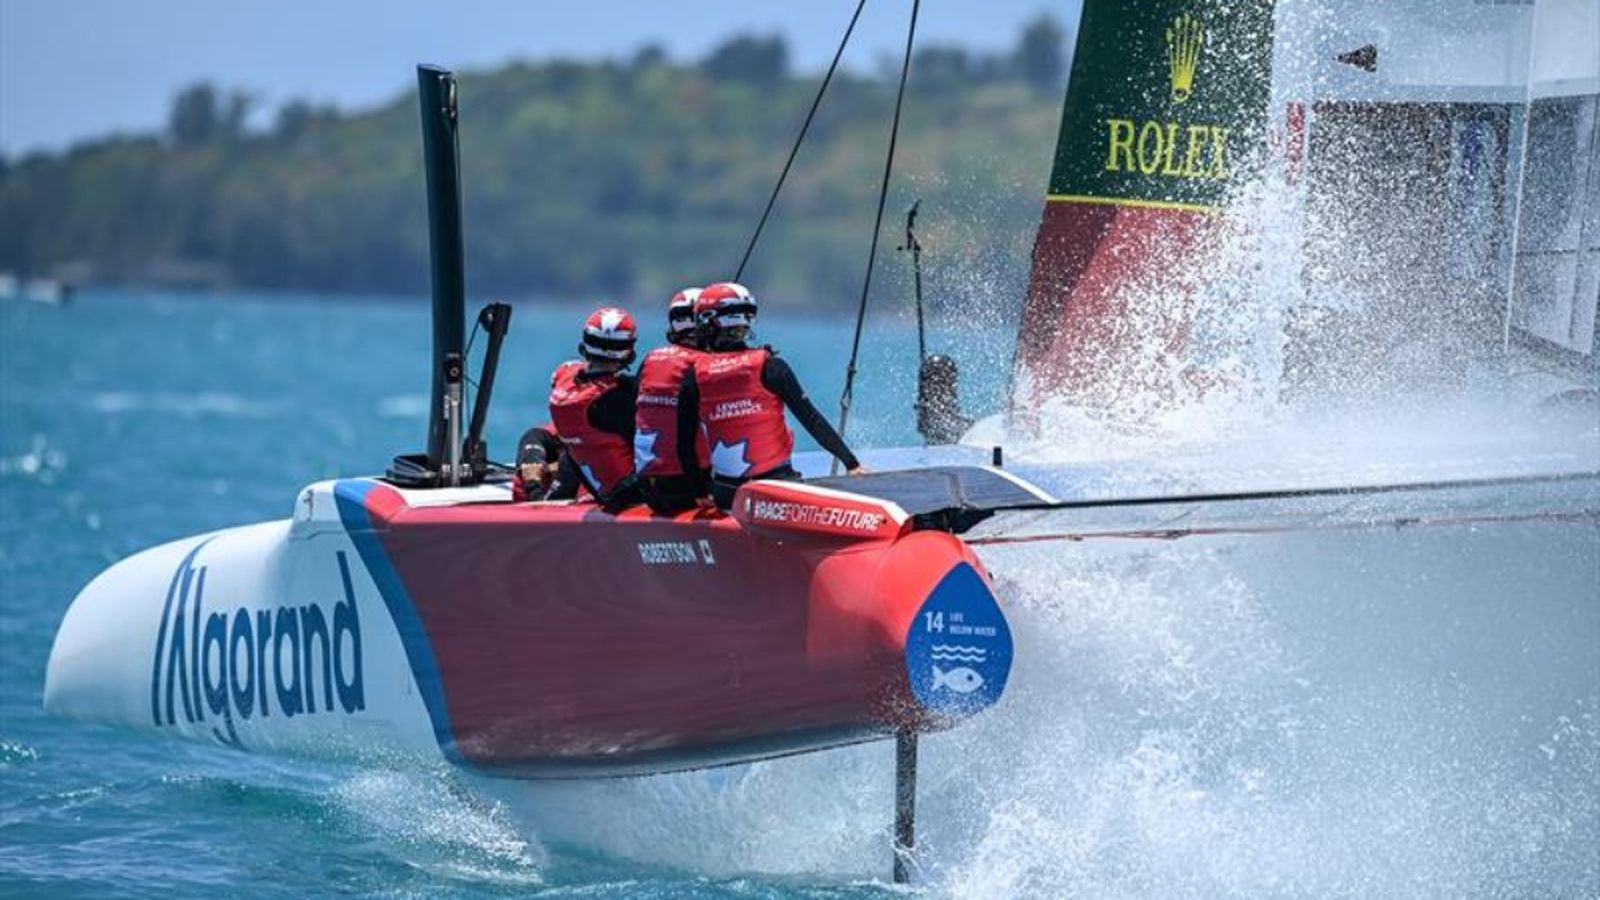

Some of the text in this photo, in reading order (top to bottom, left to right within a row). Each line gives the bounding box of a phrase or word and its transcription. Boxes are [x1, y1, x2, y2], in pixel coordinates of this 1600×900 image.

[1105, 118, 1228, 180] ROLEX
[638, 542, 697, 564] ROBERTSON
[151, 535, 366, 749] Algorand
[925, 611, 944, 632] 14
